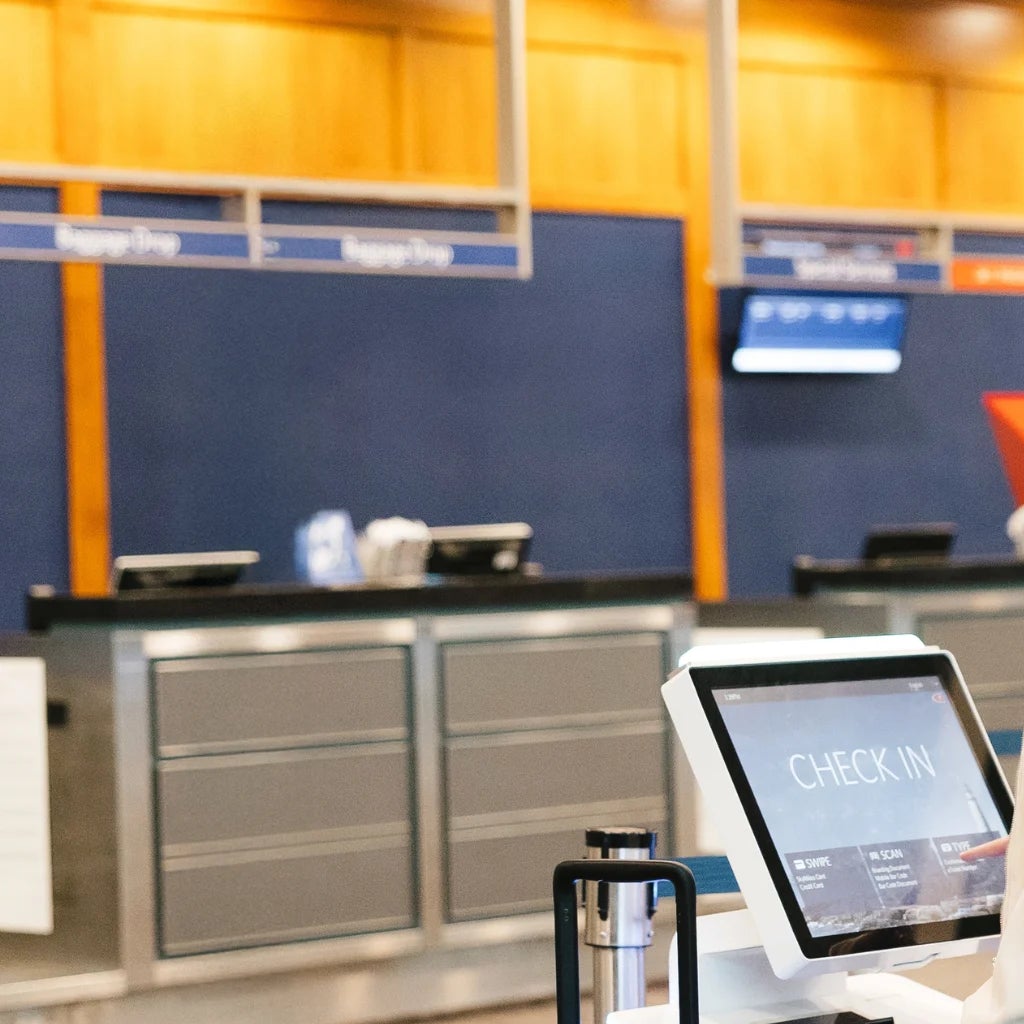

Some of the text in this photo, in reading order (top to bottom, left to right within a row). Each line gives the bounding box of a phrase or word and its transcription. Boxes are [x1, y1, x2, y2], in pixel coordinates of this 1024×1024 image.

[789, 744, 936, 789] CHECK IN
[880, 848, 904, 860] SCAN
[805, 856, 832, 868] SWIPE
